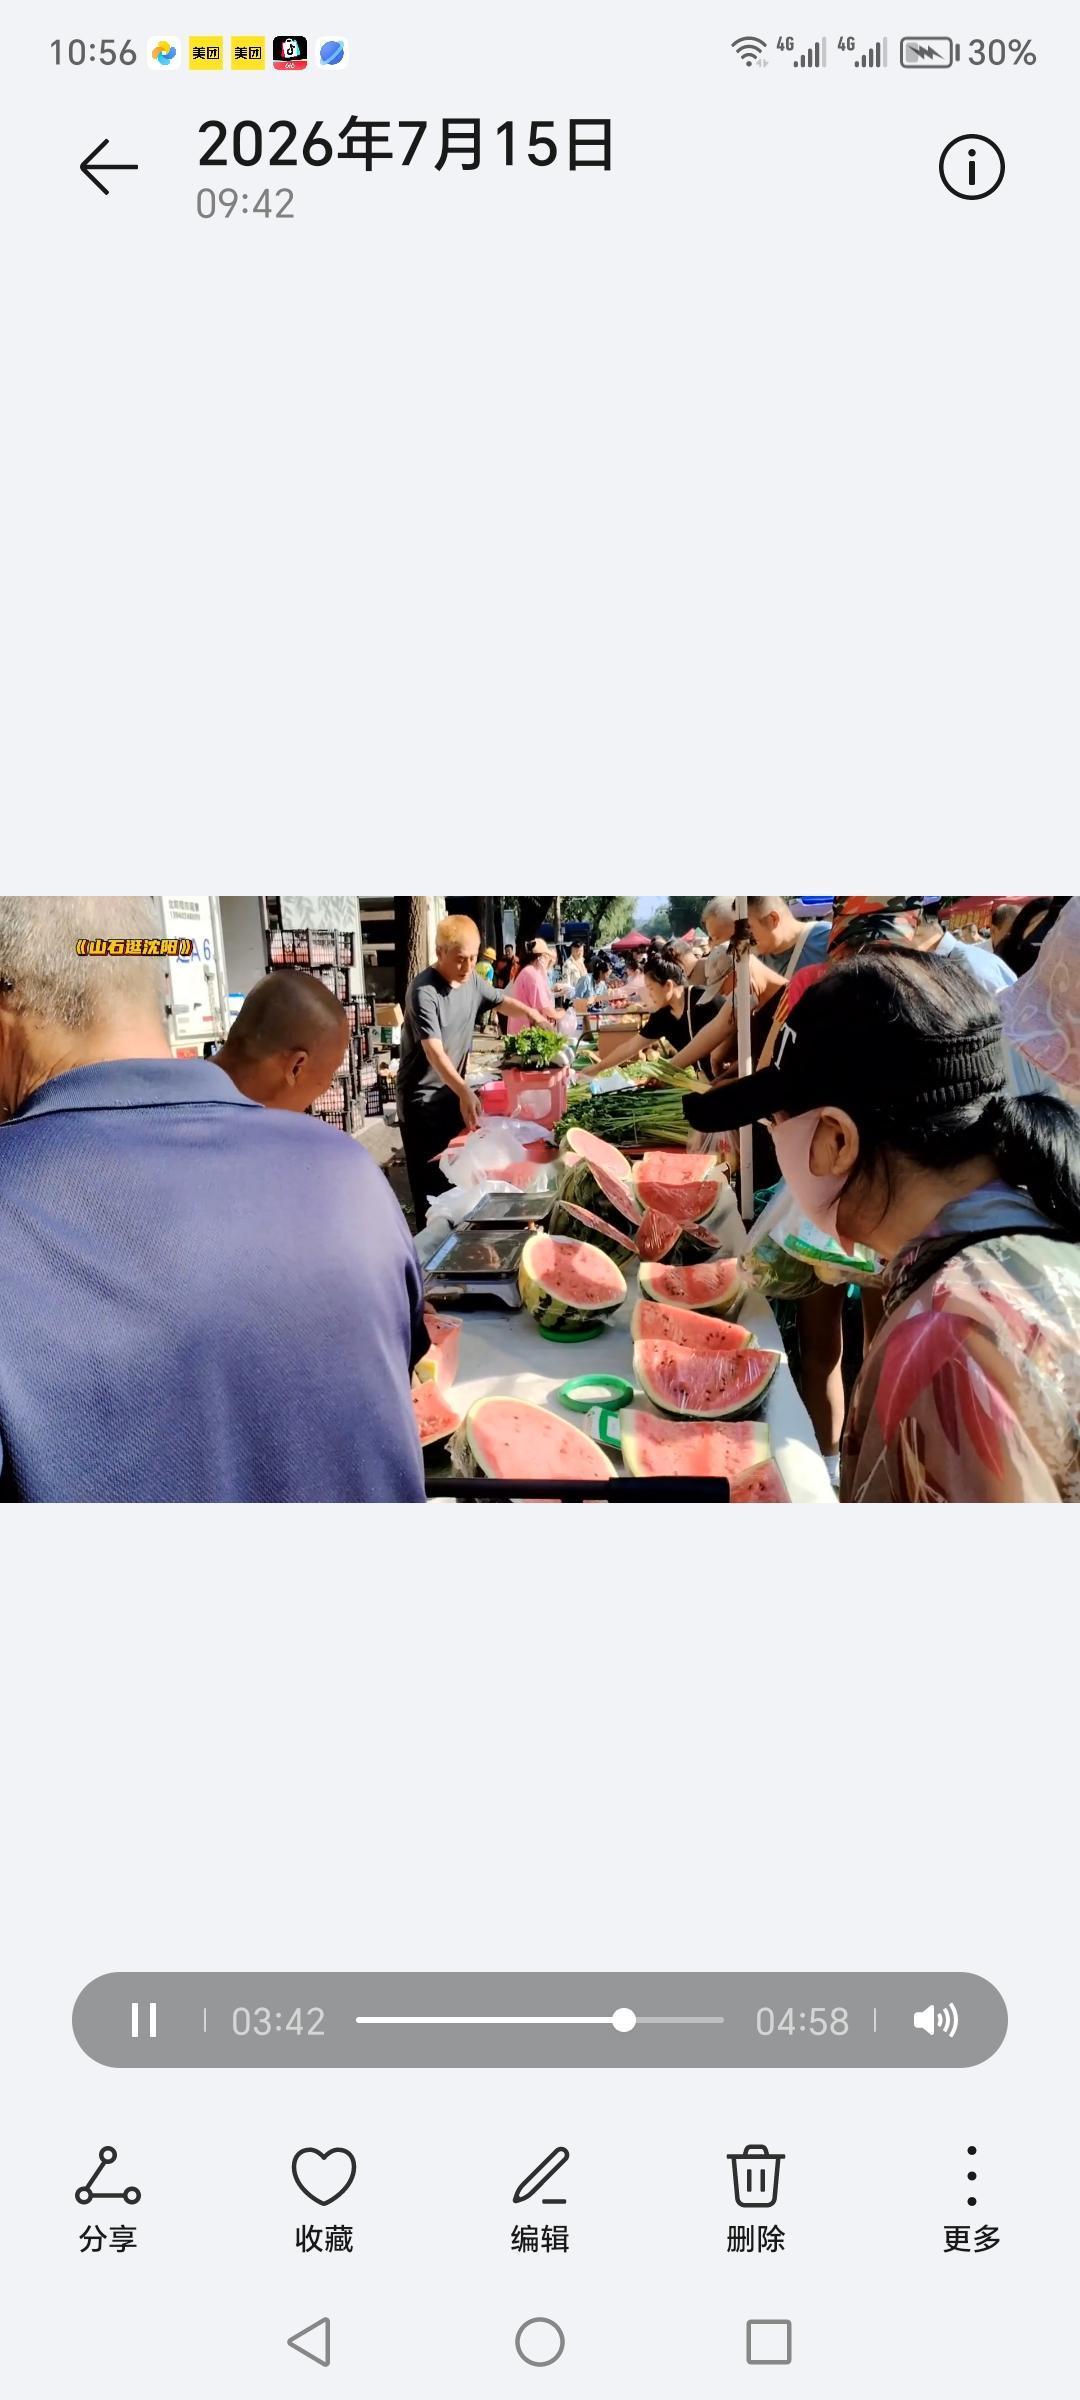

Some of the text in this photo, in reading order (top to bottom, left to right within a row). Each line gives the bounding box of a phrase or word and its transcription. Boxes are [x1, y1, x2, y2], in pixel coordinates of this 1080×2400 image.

[51, 38, 138, 66] 10:56
[192, 46, 220, 60] 美团
[234, 46, 262, 60] 美团
[775, 36, 795, 51] 4G
[836, 36, 856, 51] 4G
[968, 38, 1037, 66] 30%
[197, 115, 612, 172] 2026年7月15日
[196, 187, 295, 220] 09:42
[774, 1022, 797, 1070] T
[232, 2006, 325, 2036] 03:42
[756, 2006, 849, 2036] 04:58
[78, 2224, 138, 2254] 分享
[295, 2224, 354, 2254] 收藏
[510, 2224, 571, 2254] 编辑
[726, 2224, 787, 2254] 删除
[942, 2224, 1001, 2254] 更多
